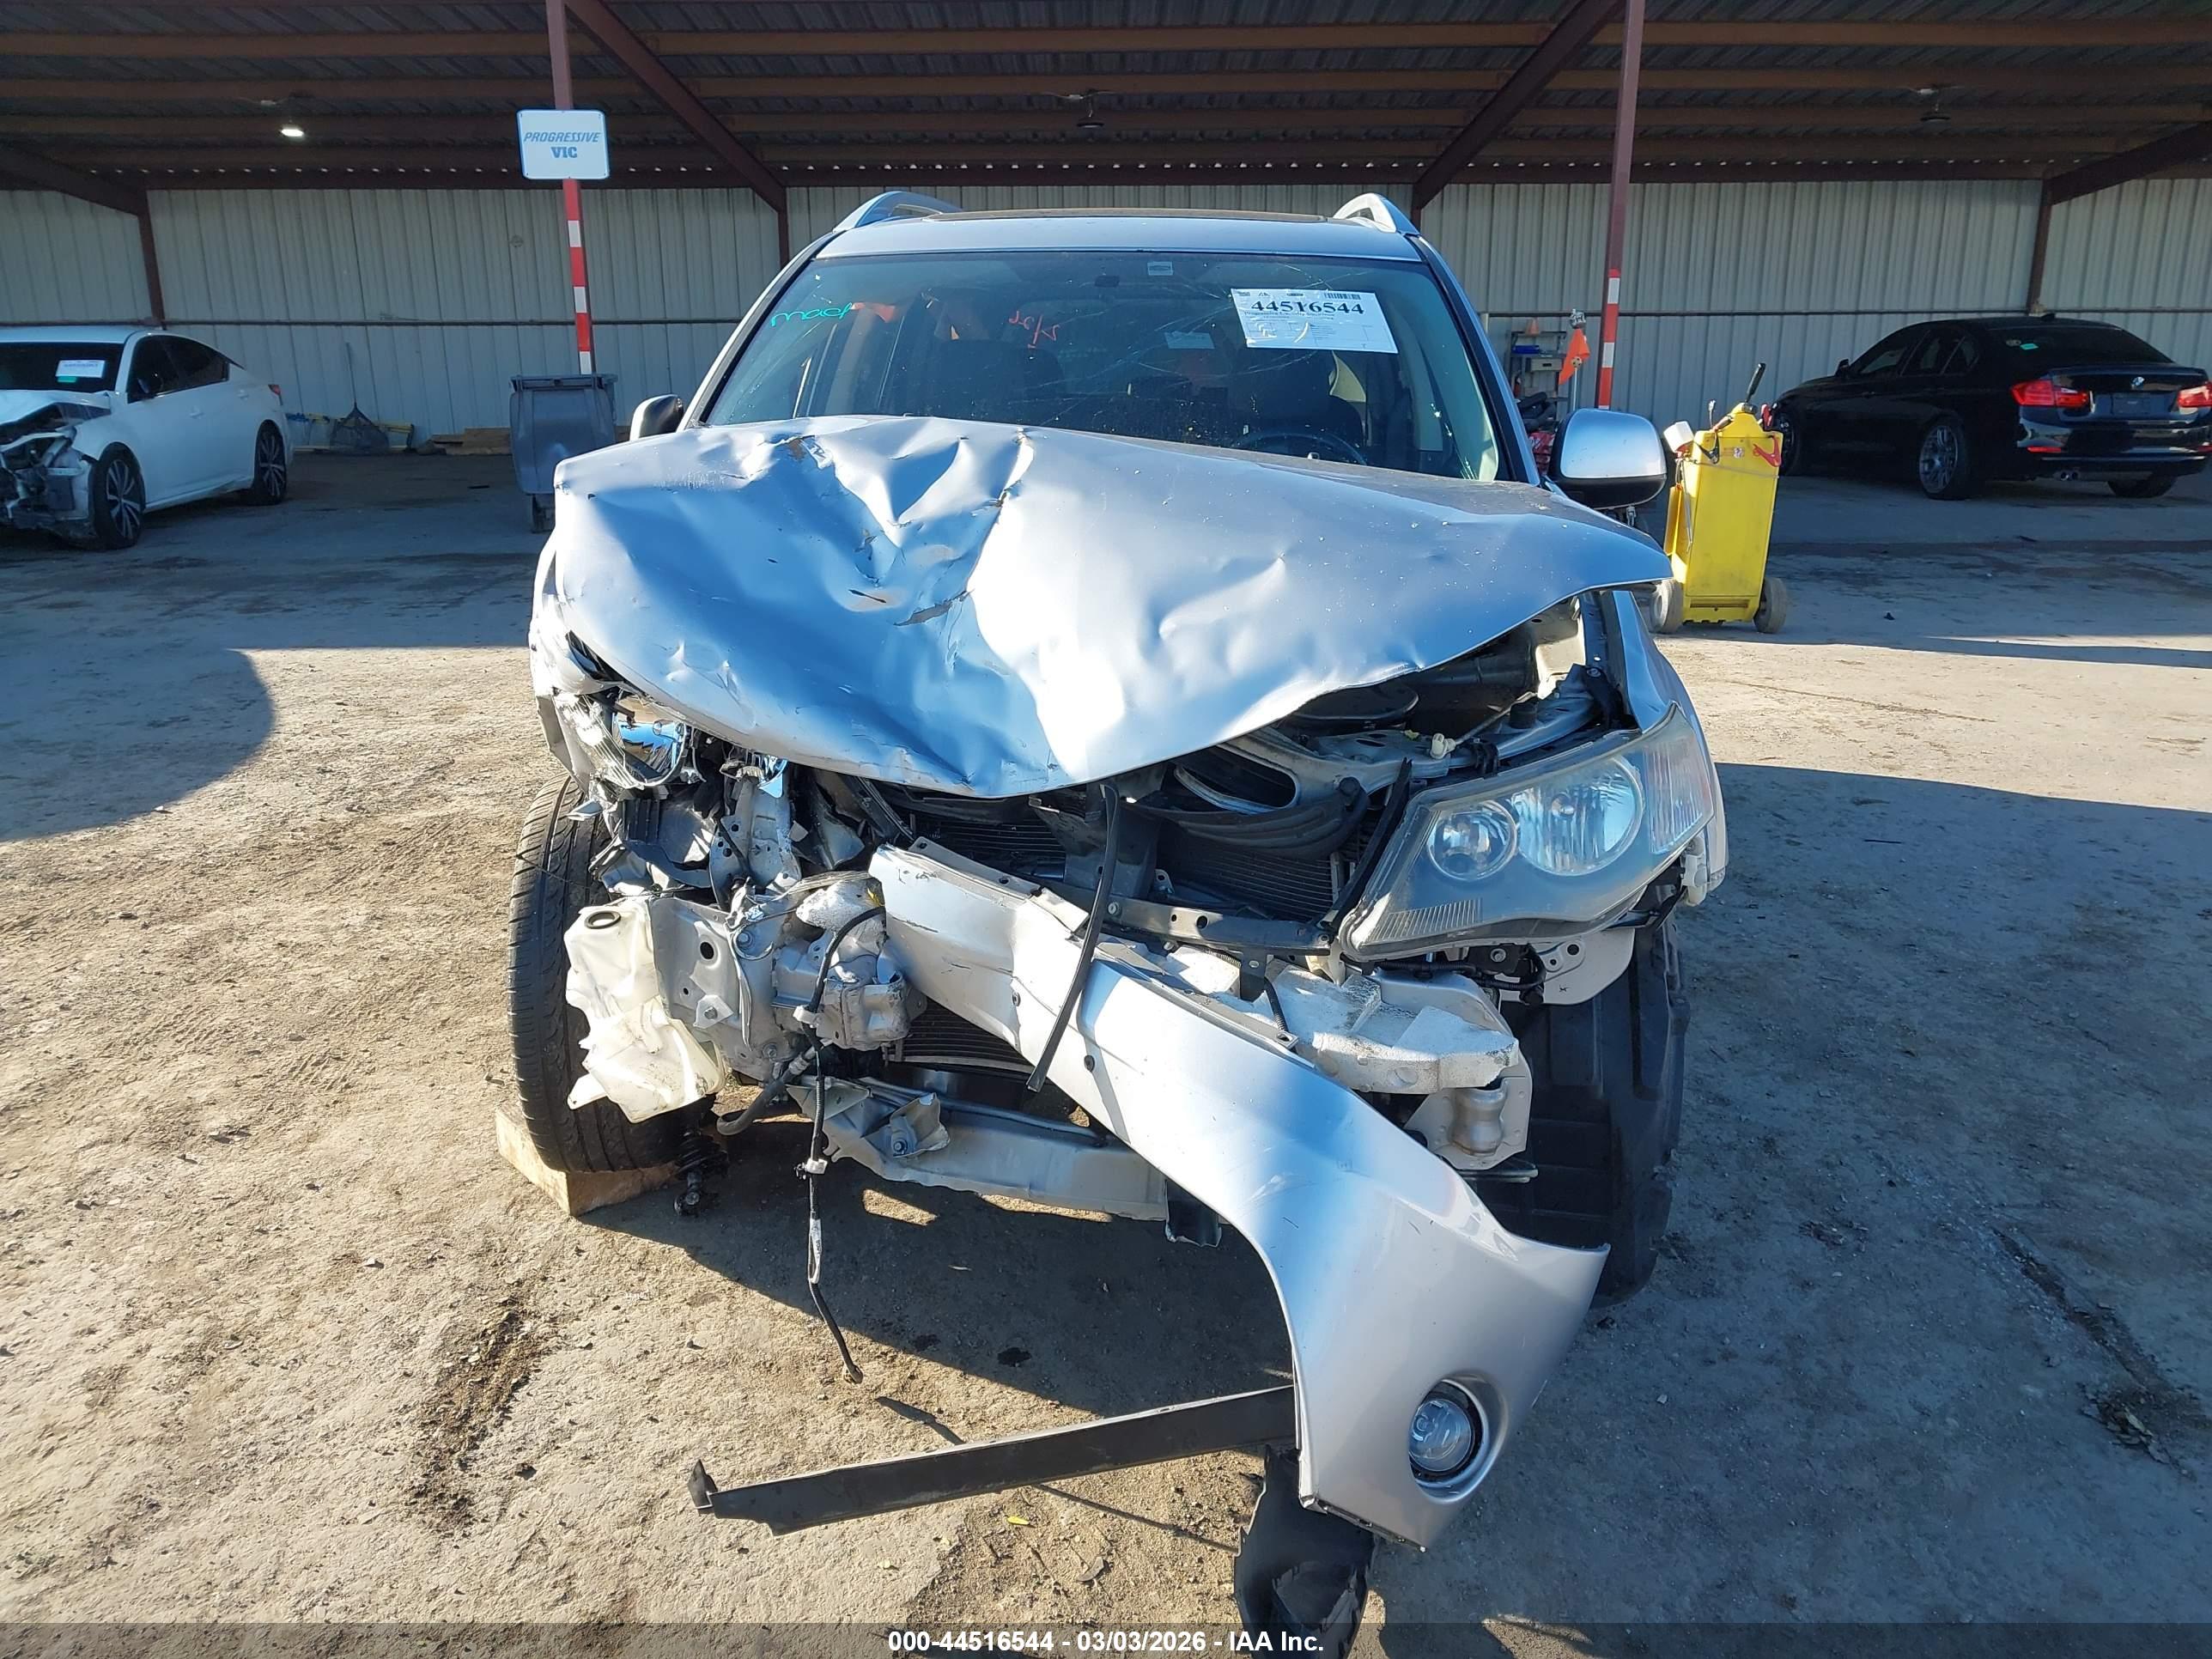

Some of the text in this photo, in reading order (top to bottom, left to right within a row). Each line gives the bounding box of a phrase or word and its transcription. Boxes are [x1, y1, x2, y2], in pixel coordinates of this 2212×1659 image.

[523, 131, 600, 143] PROGRESSIVE
[550, 146, 578, 158] VIC
[1251, 301, 1364, 314] 44516544
